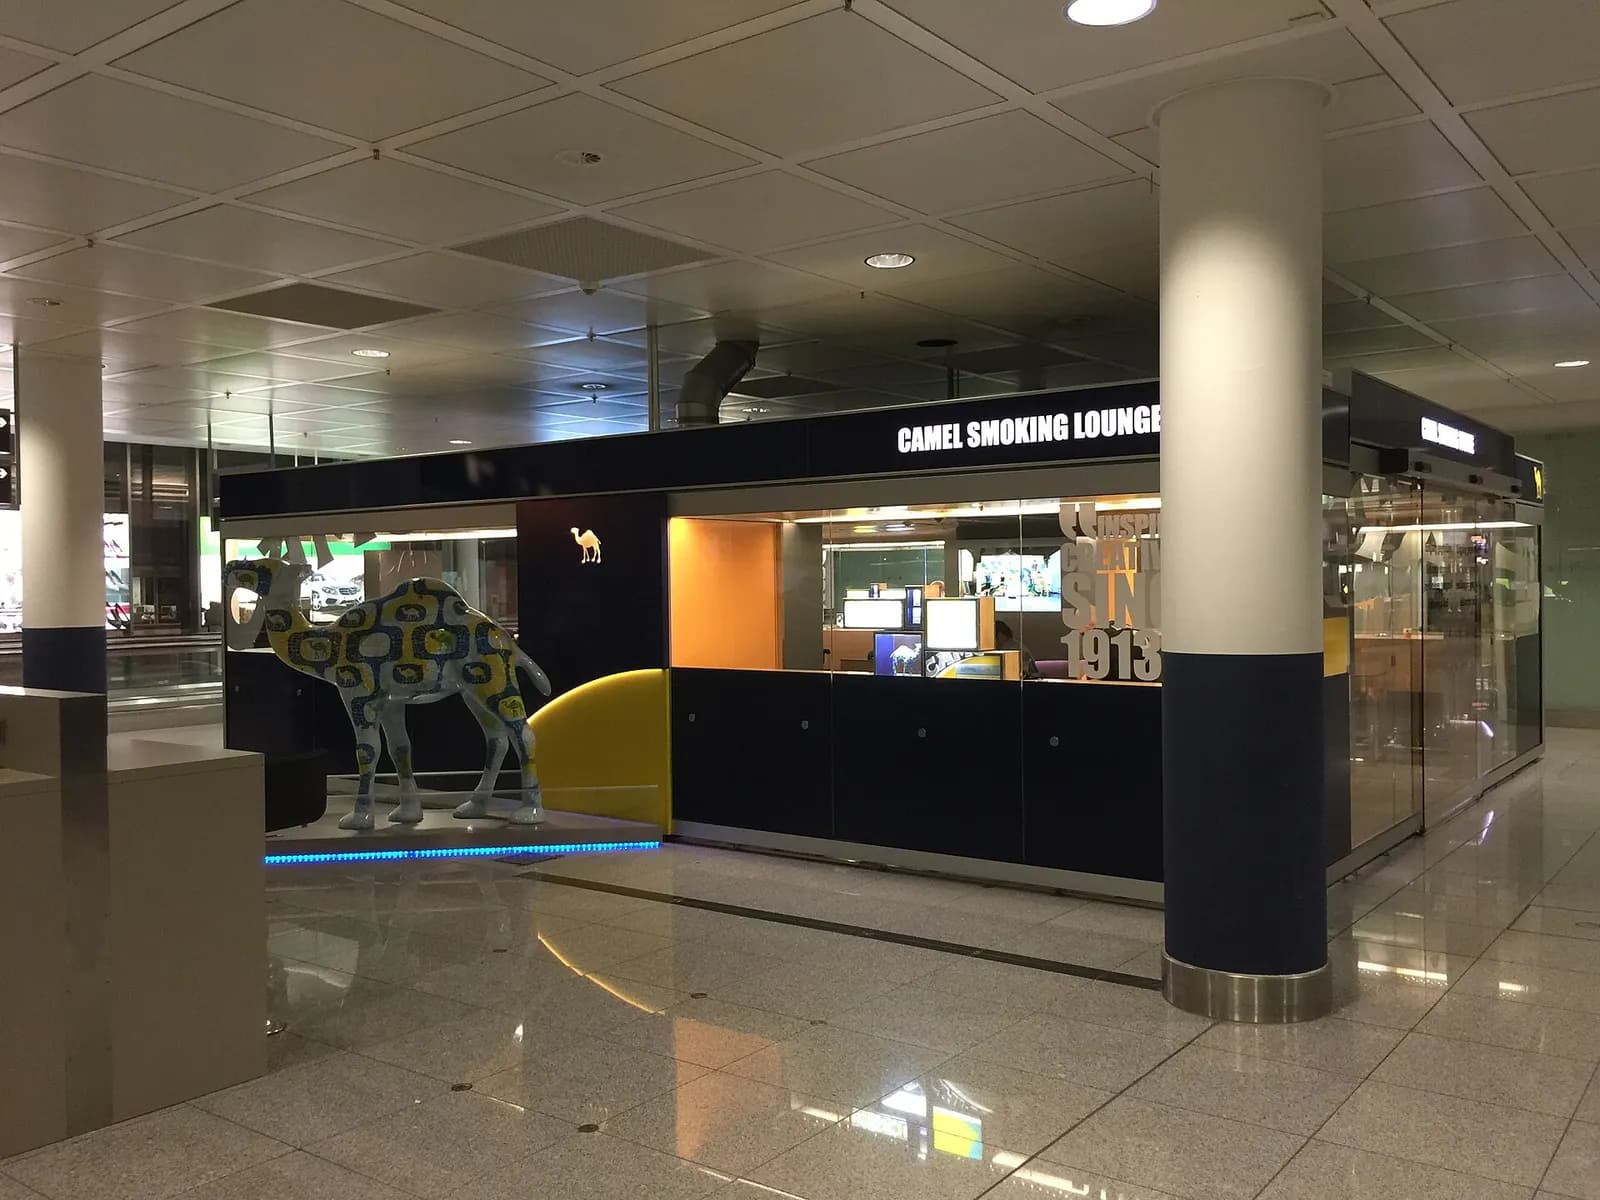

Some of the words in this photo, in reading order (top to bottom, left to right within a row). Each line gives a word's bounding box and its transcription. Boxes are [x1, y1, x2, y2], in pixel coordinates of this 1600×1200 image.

[898, 422, 963, 453] CAMEL
[967, 413, 1068, 448] SMOKING
[1074, 404, 1160, 439] LOUNGE
[1060, 628, 1162, 681] 1913
